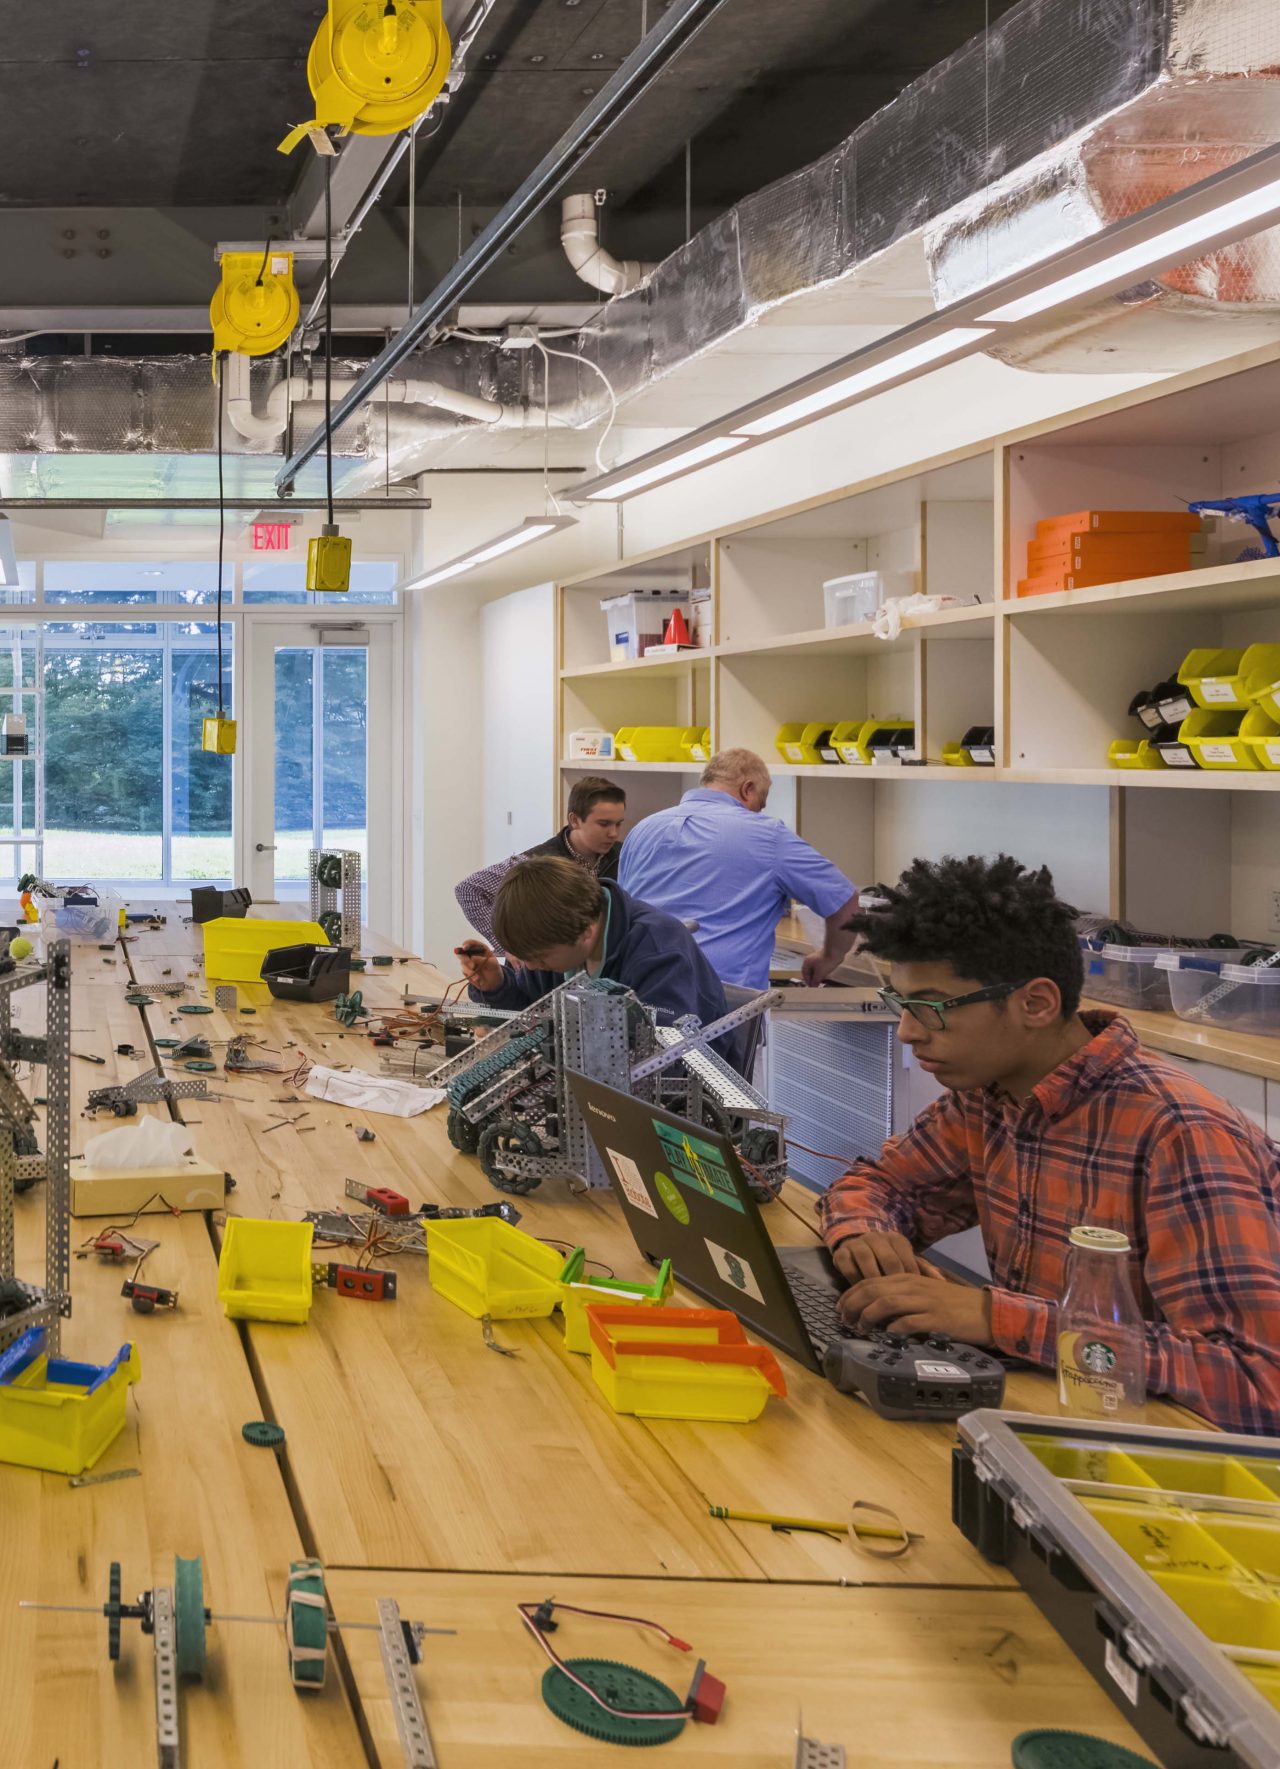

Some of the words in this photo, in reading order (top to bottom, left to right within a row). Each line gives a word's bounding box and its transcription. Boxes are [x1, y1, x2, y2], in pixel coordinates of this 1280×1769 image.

[253, 523, 291, 550] EXIT
[587, 1101, 616, 1122] lenovo
[663, 1143, 687, 1169] PLAY
